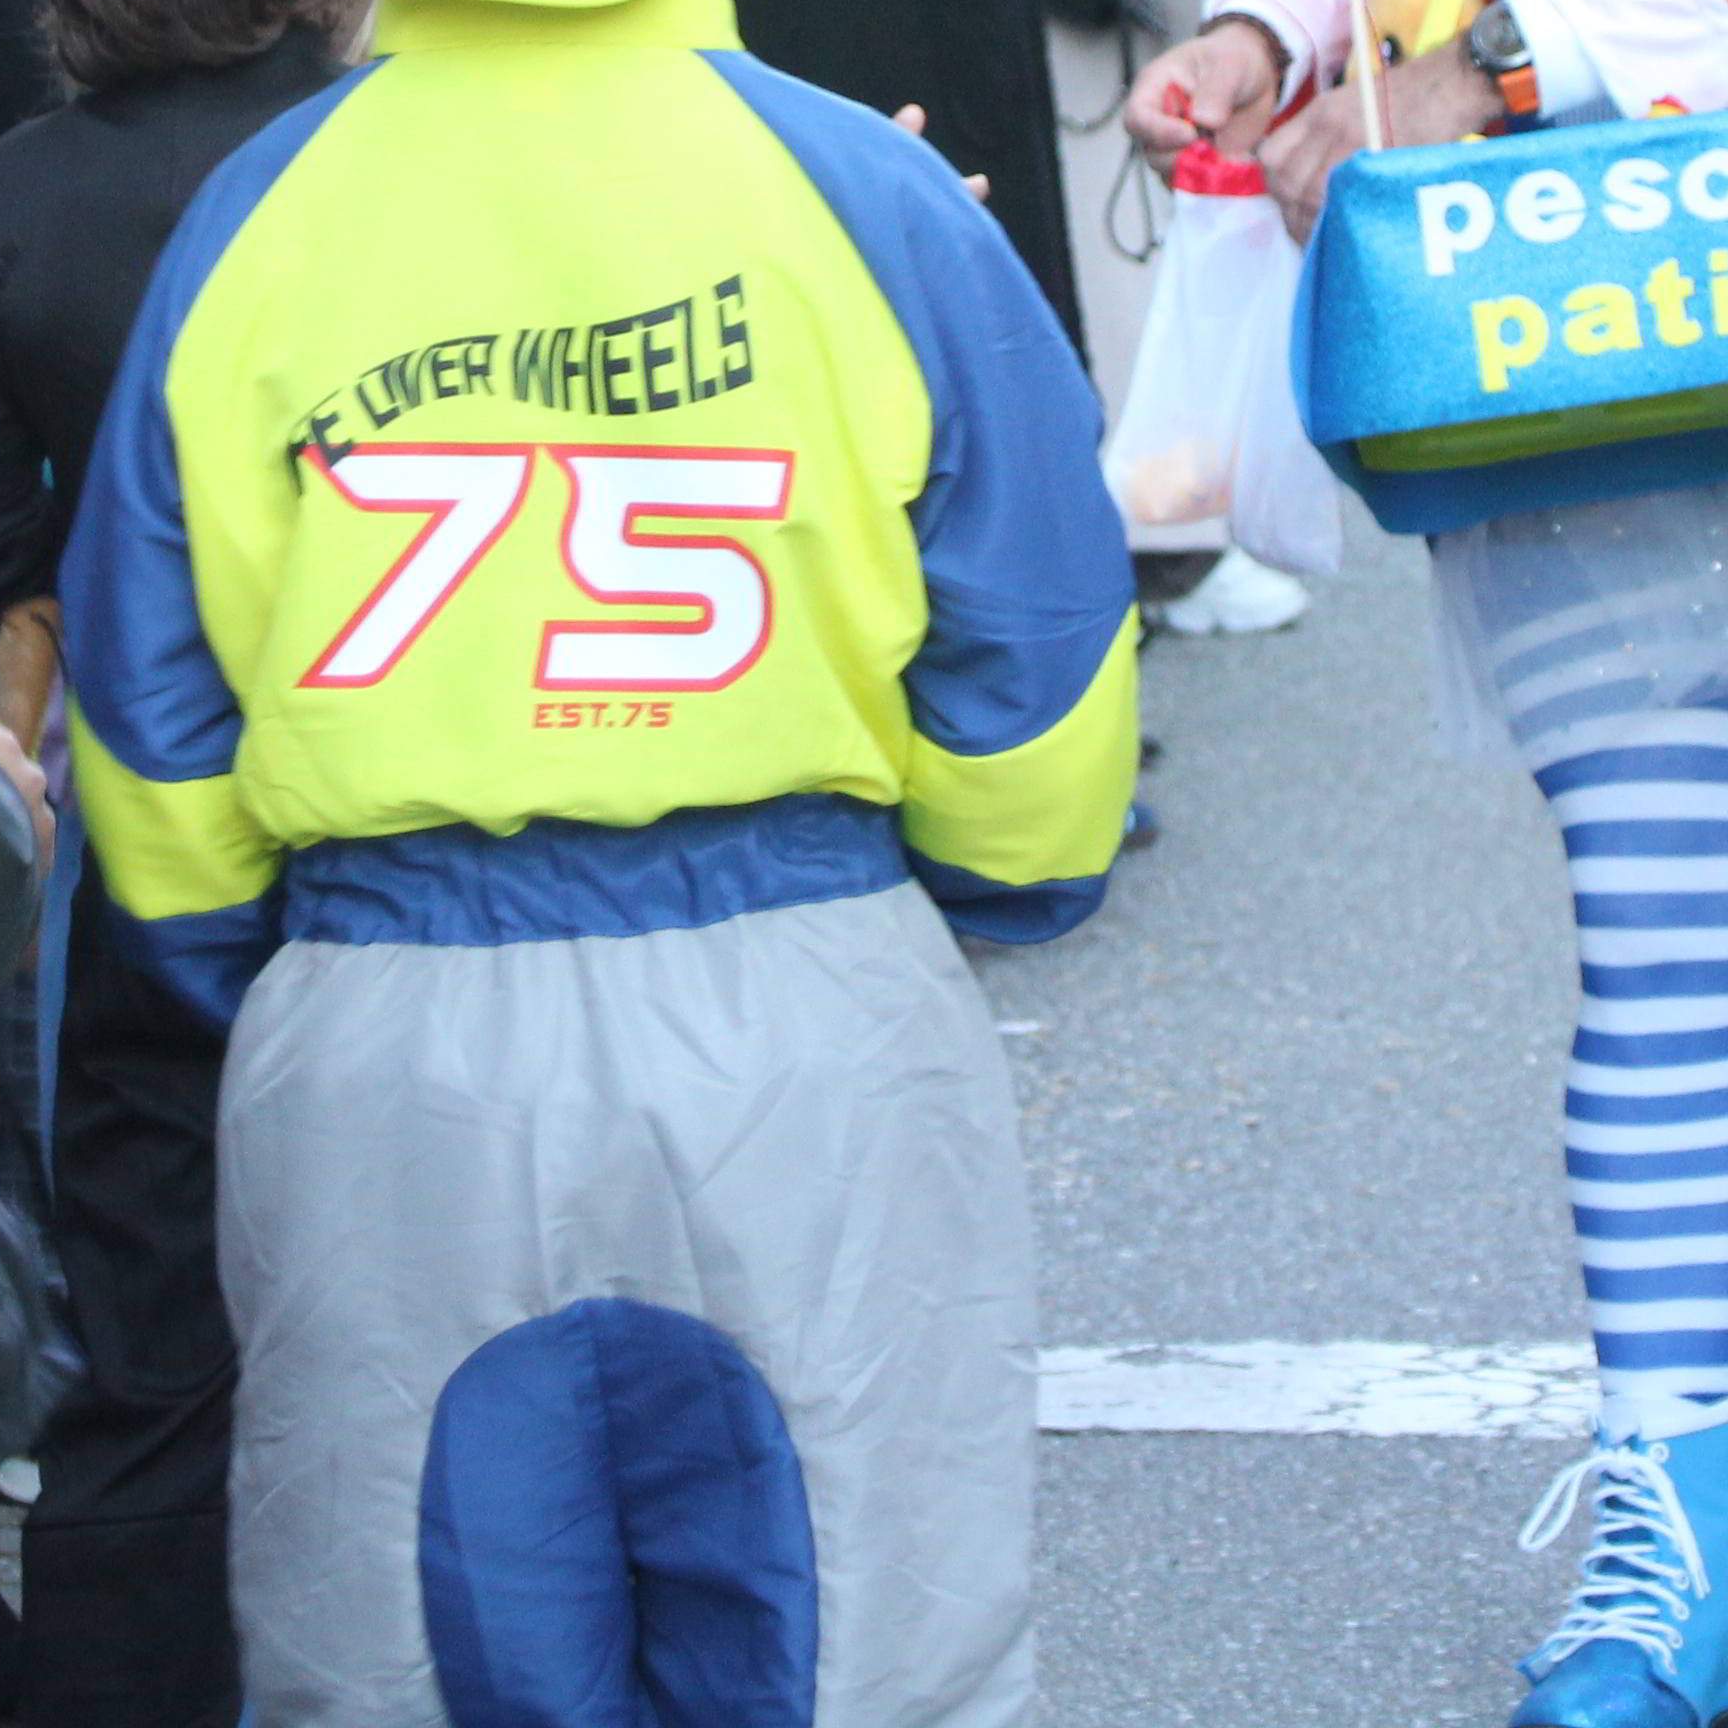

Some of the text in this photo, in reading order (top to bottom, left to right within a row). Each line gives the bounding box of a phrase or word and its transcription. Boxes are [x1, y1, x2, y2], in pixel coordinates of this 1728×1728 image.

[357, 333, 502, 431] OVER
[512, 274, 754, 417] WHEELS
[295, 442, 796, 693] 75
[533, 702, 674, 729] EST.75
